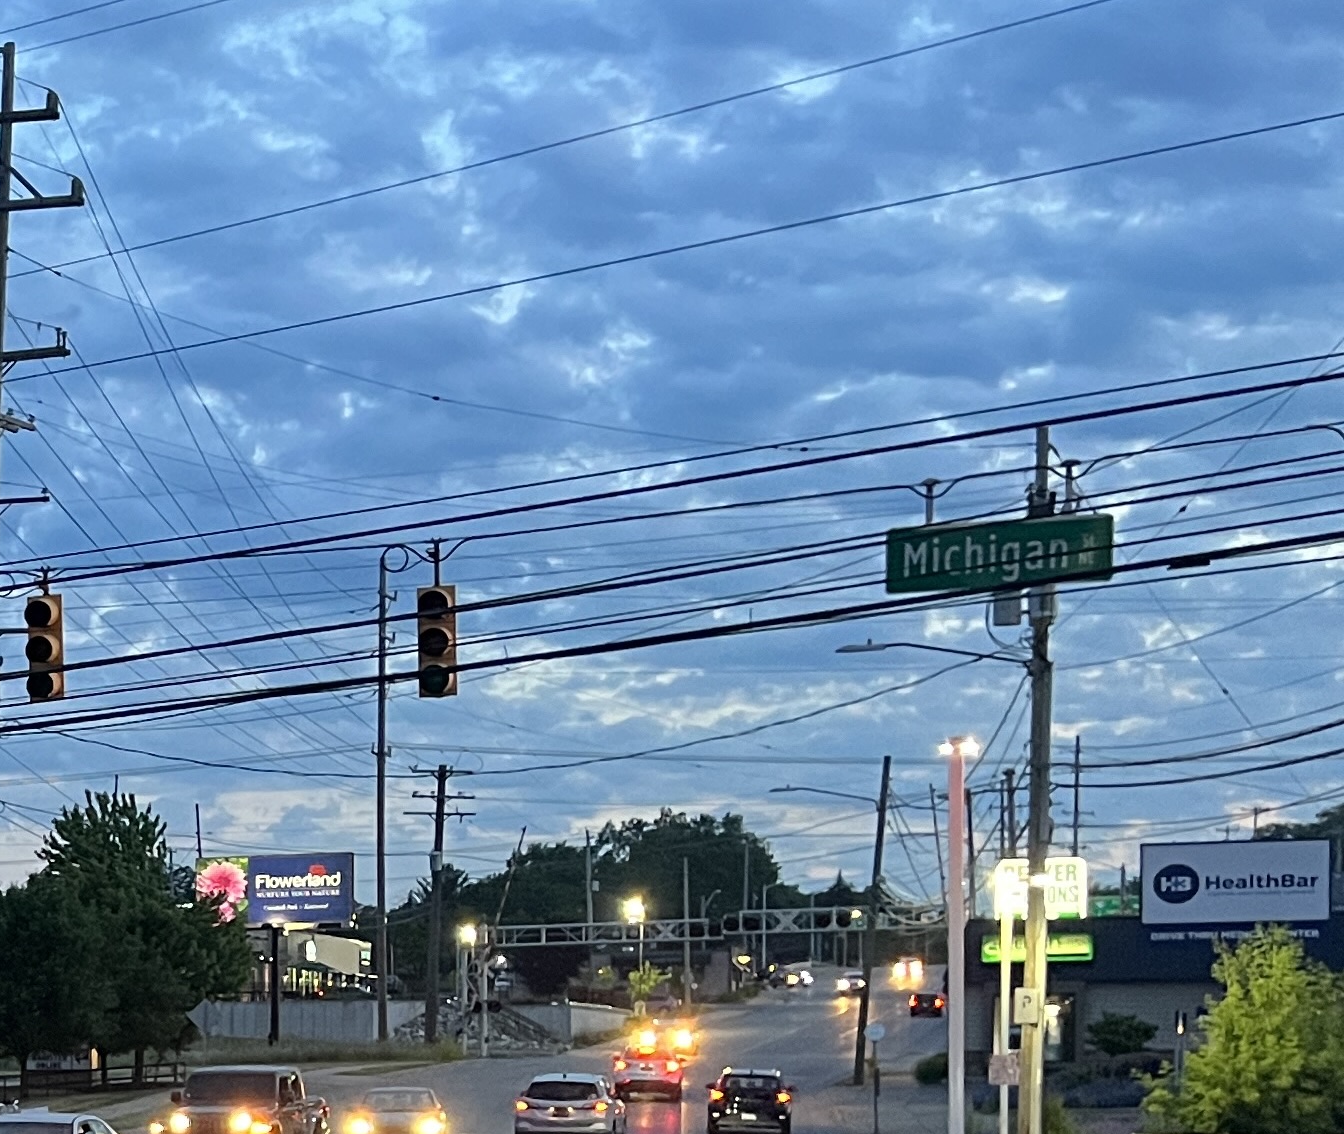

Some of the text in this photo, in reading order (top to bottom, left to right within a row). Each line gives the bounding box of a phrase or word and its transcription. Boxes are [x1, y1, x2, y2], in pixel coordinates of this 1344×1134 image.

[903, 534, 1068, 582] Michigan
[254, 871, 342, 890] Flowerland
[1204, 873, 1320, 891] HealthBar
